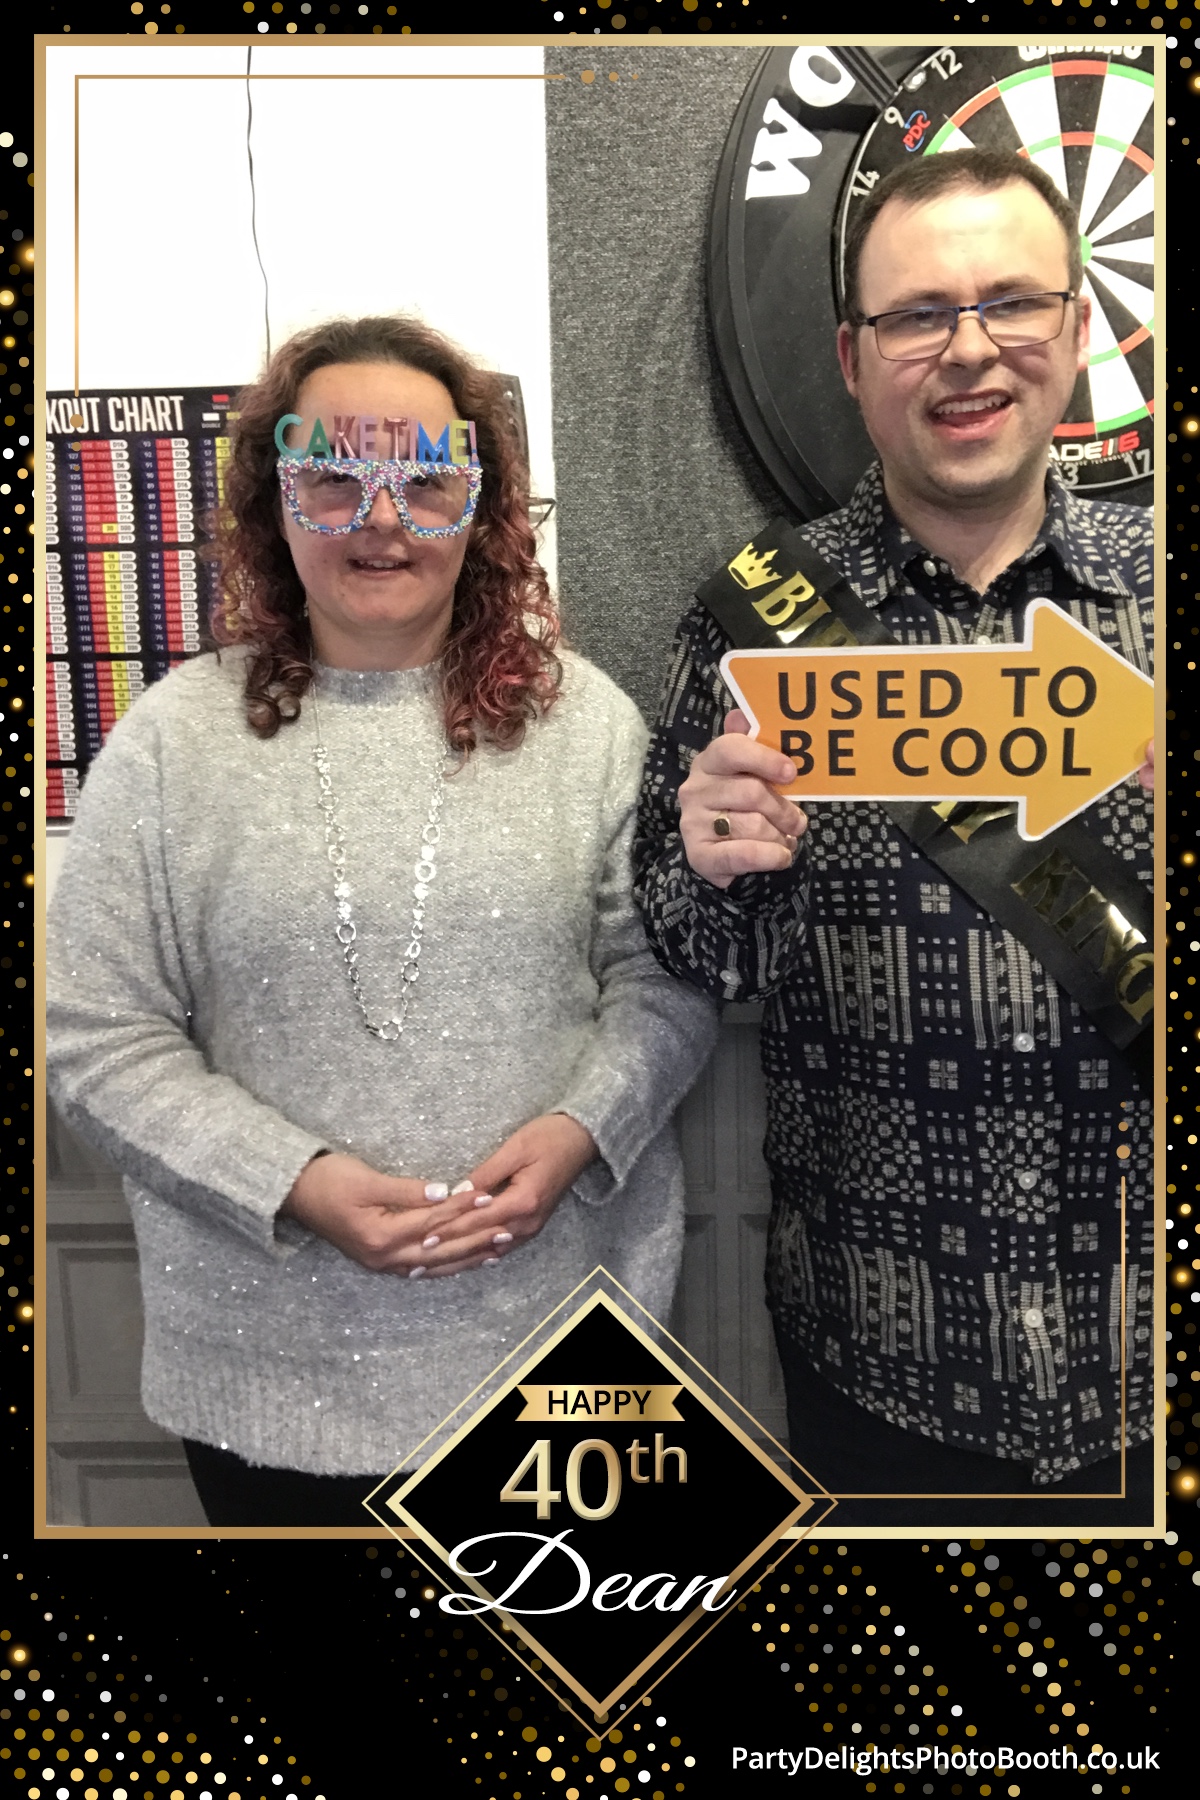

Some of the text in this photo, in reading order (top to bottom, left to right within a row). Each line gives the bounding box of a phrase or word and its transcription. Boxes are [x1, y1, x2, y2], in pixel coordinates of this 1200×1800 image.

[931, 48, 963, 80] 12
[884, 106, 905, 128] 9
[903, 115, 931, 148] PDC
[851, 170, 880, 197] 14
[107, 395, 184, 433] CHART
[274, 413, 380, 459] CAKE
[1124, 448, 1151, 478] 17
[778, 666, 1098, 721] USED TO
[779, 727, 1093, 777] BE COOL
